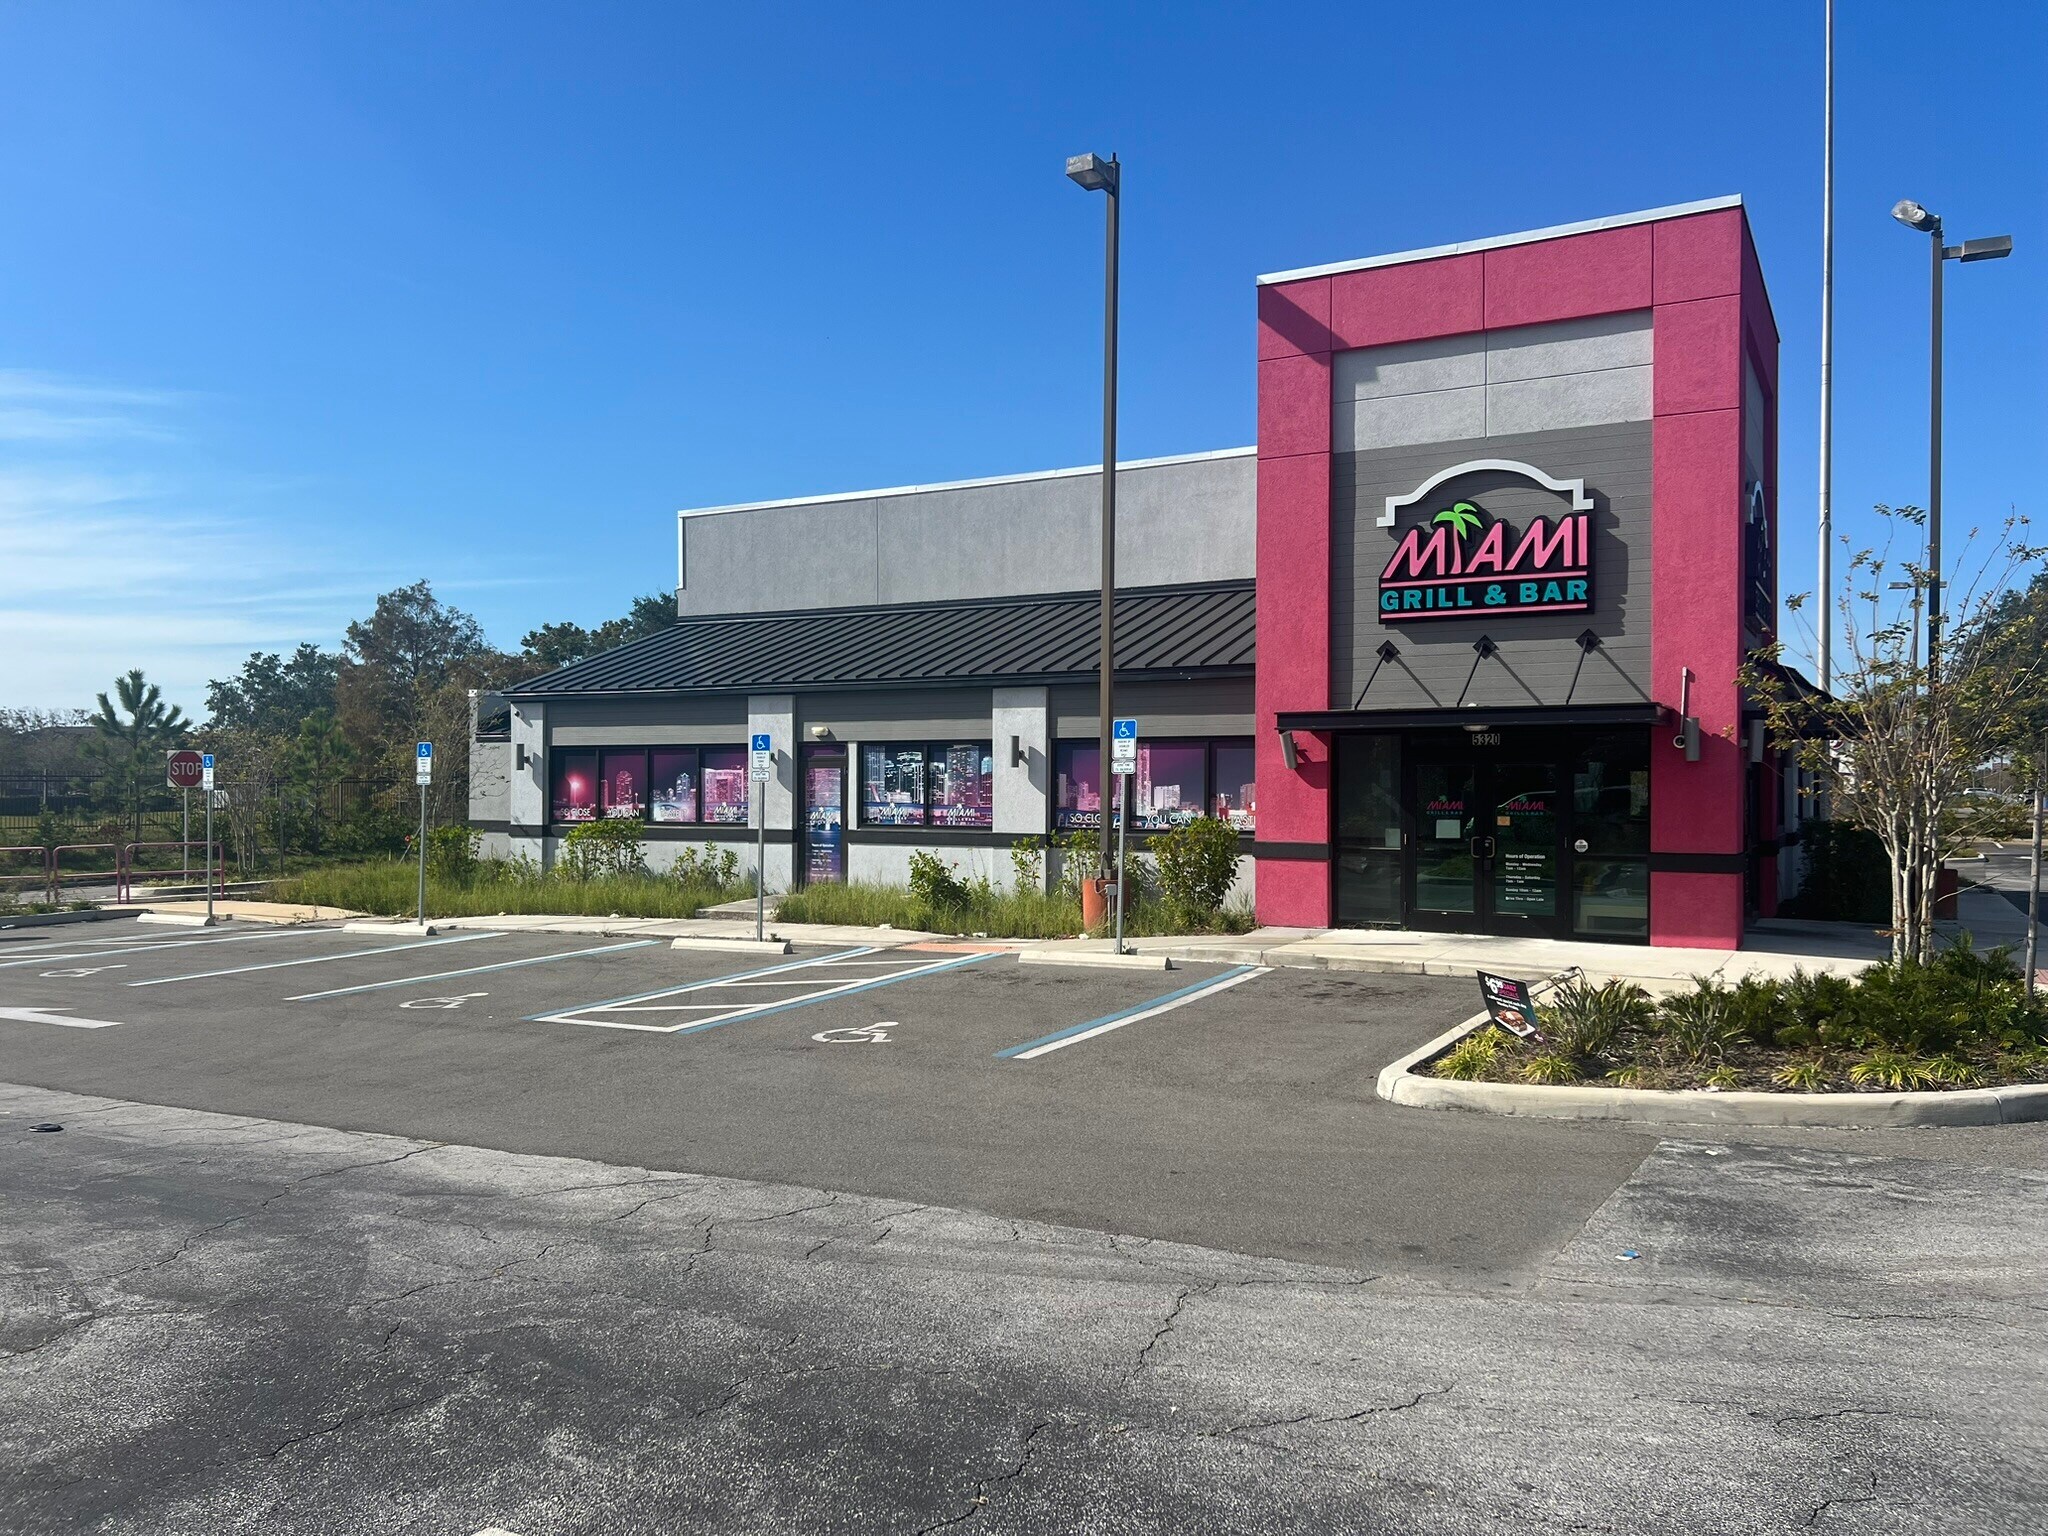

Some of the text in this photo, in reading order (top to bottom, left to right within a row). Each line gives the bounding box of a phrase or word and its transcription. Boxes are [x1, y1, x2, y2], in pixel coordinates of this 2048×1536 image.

[1382, 514, 1588, 578] MIAMI
[1380, 580, 1588, 611] GRILL & BAR
[1473, 734, 1500, 745] 5320
[171, 762, 202, 776] STOP
[1426, 801, 1464, 810] MIAMI
[1505, 801, 1545, 811] MIAMI
[1069, 813, 1083, 823] SO
[1145, 814, 1192, 825] YOU CAN
[1229, 815, 1255, 825] TAST
